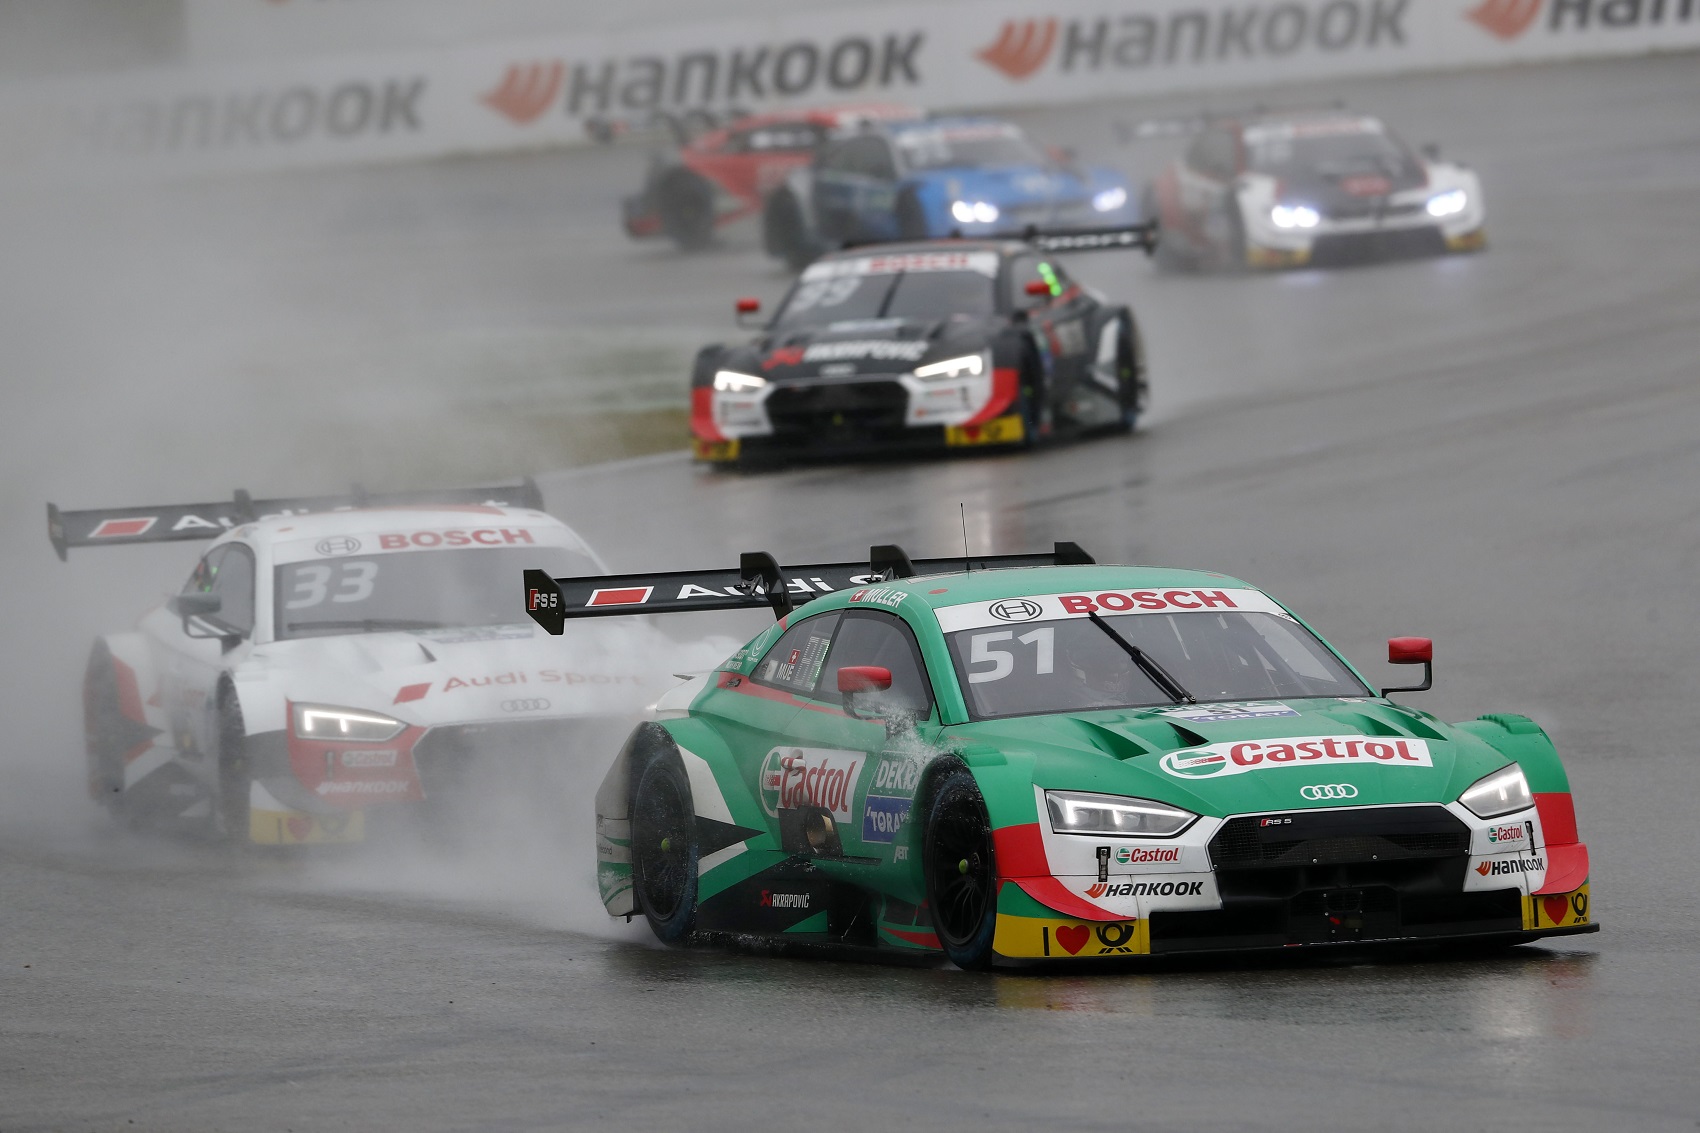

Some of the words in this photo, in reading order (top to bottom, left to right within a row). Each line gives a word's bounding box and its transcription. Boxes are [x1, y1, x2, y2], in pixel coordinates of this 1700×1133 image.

[378, 529, 535, 550] BOSCH
[285, 561, 379, 610] 33
[862, 586, 908, 608] MÜLLER
[1058, 590, 1238, 614] BOSCH
[968, 627, 1055, 684] 51
[442, 671, 528, 692] Audi
[538, 669, 646, 686] Sport
[1230, 738, 1419, 766] Castrol
[781, 758, 857, 813] Castrol
[1498, 825, 1523, 841] Castrol
[1130, 847, 1179, 863] Castrol
